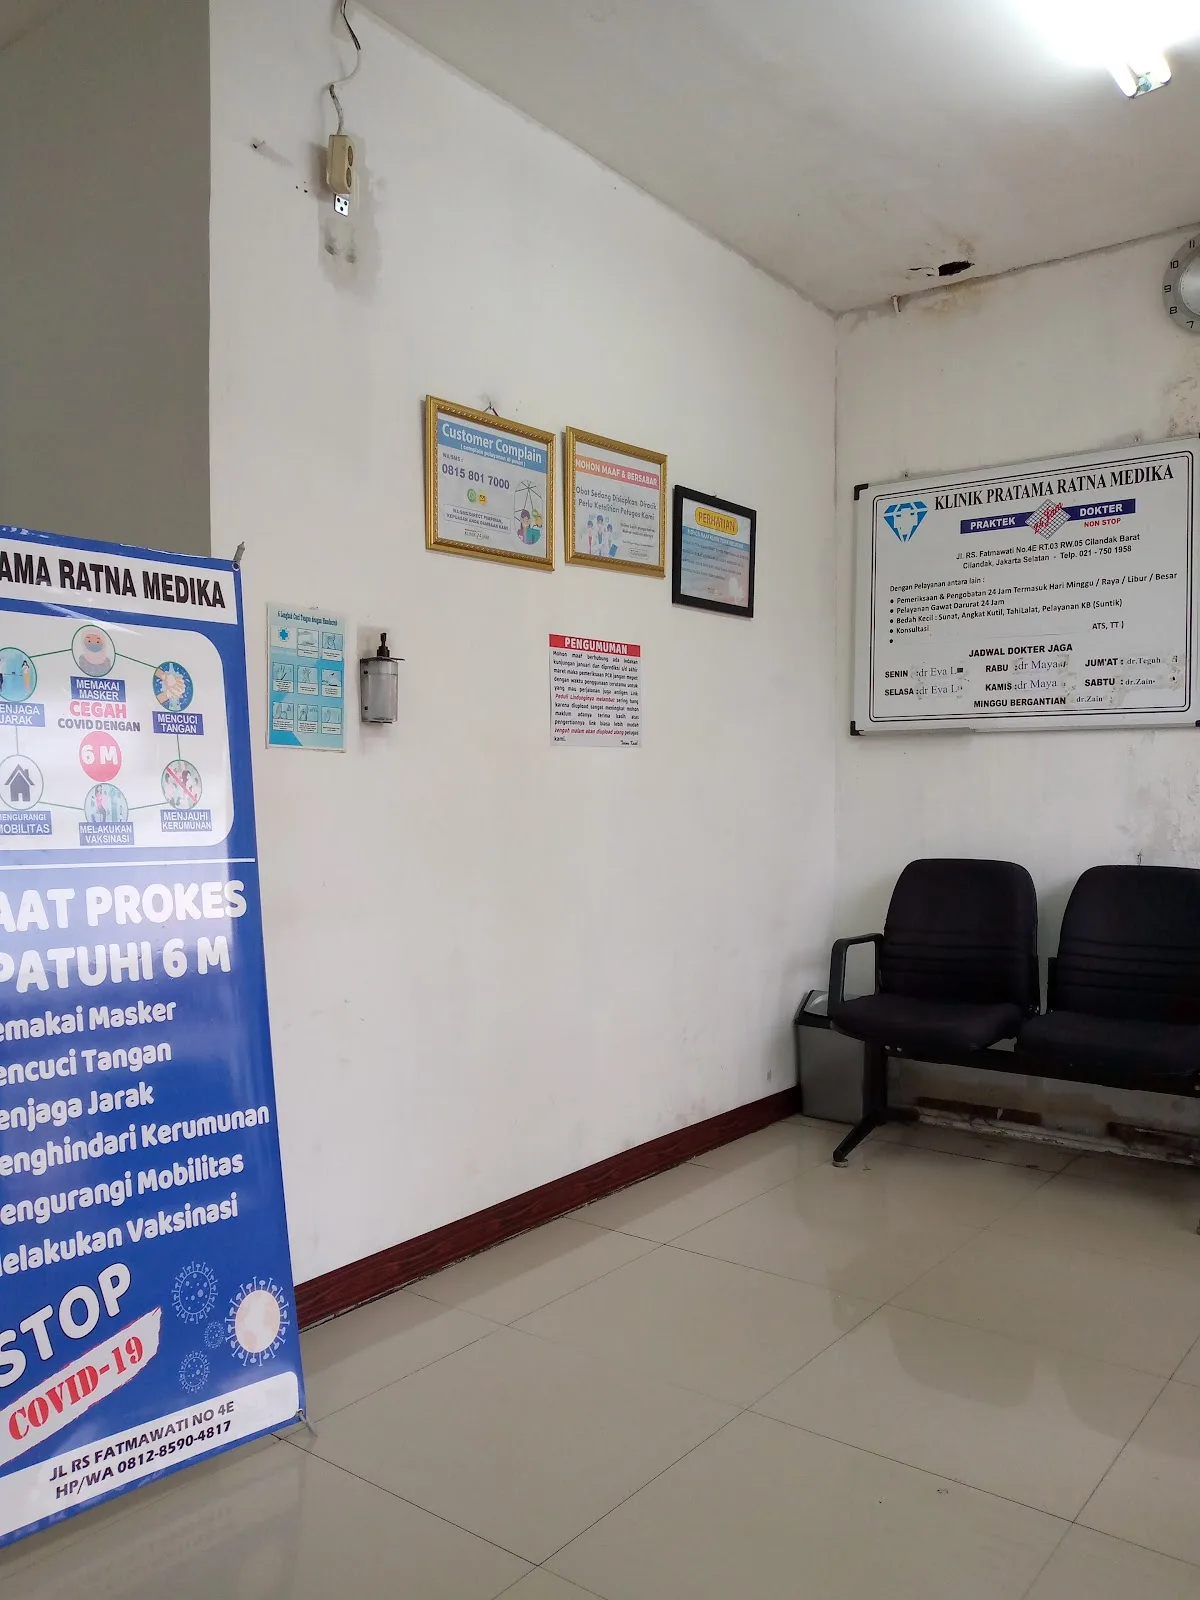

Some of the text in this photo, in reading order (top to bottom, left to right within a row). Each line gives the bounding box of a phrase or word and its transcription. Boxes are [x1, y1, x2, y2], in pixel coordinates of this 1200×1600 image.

[1170, 260, 1178, 269] 10
[1164, 285, 1171, 293] 9
[1170, 306, 1177, 314] 8
[442, 423, 493, 449] Customer
[496, 438, 542, 463] Complain
[442, 464, 509, 489] 0815 801 7000
[602, 466, 620, 476] MAAF
[627, 472, 657, 486] BERSABAR
[934, 464, 1173, 510] KLINIK PRATAMA RATNA MEDIKA
[576, 486, 656, 510] Obat Sedang Diracik
[579, 499, 592, 508] Perlu
[621, 508, 640, 518] Petugas
[641, 511, 654, 520] Kami
[971, 503, 1123, 530] PRAKTEK DOKTER
[699, 512, 735, 531] PERHATIAN
[1084, 518, 1121, 528] NON STOP
[980, 547, 1014, 557] Fatmawati
[1016, 544, 1037, 553] No.4E
[1039, 543, 1059, 551] RT.03
[1060, 540, 1083, 549] RW.05
[1085, 536, 1118, 546] Cilandak
[1120, 534, 1140, 542] Barat
[963, 560, 994, 569] Cilandak,
[996, 557, 1021, 566] Jakarta
[1023, 555, 1049, 563] Selatan
[1060, 552, 1077, 560] Telp.
[1099, 547, 1112, 555] 750
[1115, 545, 1132, 554] 1958
[0, 551, 225, 608] AMA RATNA MEDIKA
[914, 581, 946, 590] Pelayanan
[897, 595, 938, 604] Pemeriksaan
[947, 591, 986, 600] Pengobatan
[1014, 584, 1048, 594] Termasuk
[1049, 582, 1064, 590] Hari
[1066, 580, 1094, 588] Minggu
[1102, 578, 1120, 586] Raya
[1128, 575, 1147, 583] Libur
[897, 606, 929, 614] Pelayanan
[962, 611, 985, 619] Angkat
[1042, 603, 1079, 612] Pelayanan
[1093, 599, 1122, 609] (Suntik)
[897, 626, 929, 634] Konsultasi
[1110, 621, 1119, 629] TT
[565, 637, 627, 654] PENGUMUMAN
[969, 644, 1073, 657] JADWAL DOKTER JAGA
[553, 659, 575, 667] kunjungan
[588, 654, 608, 662] berhubung
[1085, 658, 1118, 667] JUM'AT
[885, 670, 908, 678] SENIN
[930, 668, 947, 676] Eva
[986, 664, 1008, 672] RABU
[76, 679, 120, 691] MEMAKAI
[885, 688, 914, 696] SELASA
[931, 685, 948, 694] Eva
[986, 680, 1057, 691] KAMIS Maya
[1085, 678, 1115, 686] SABTU
[79, 689, 119, 701] MASKER
[974, 699, 1007, 708] MINGGU
[1010, 696, 1066, 706] BERGANTIAN
[69, 700, 127, 719] CEGAH
[58, 717, 141, 733] COVID DENGAN
[158, 713, 198, 725] MENCUCI
[160, 723, 197, 734] TANGAN
[81, 744, 118, 765] 6 M
[163, 811, 208, 821] MENJAUHI
[80, 824, 132, 835] MELAKUKAN
[162, 820, 212, 830] KERUMUNAN
[85, 834, 130, 843] VAKSINASI
[85, 879, 247, 927] PROKES
[162, 938, 188, 978] 6
[197, 935, 231, 975] M
[89, 1001, 177, 1030] Masker
[81, 1042, 172, 1072] Tangan
[88, 1081, 154, 1115] Jarak
[142, 1105, 270, 1148] Kerumunan
[0, 1152, 244, 1225] engurangi Mobilitas
[0, 1192, 239, 1277] elakukan Vaksinasi
[0, 1263, 131, 1388] STOP
[8, 1336, 144, 1441] COVID-19
[49, 1400, 235, 1482] JL RS FATMAWATI NO 4E
[55, 1420, 232, 1500] HP/WA 0812-8590-4817
